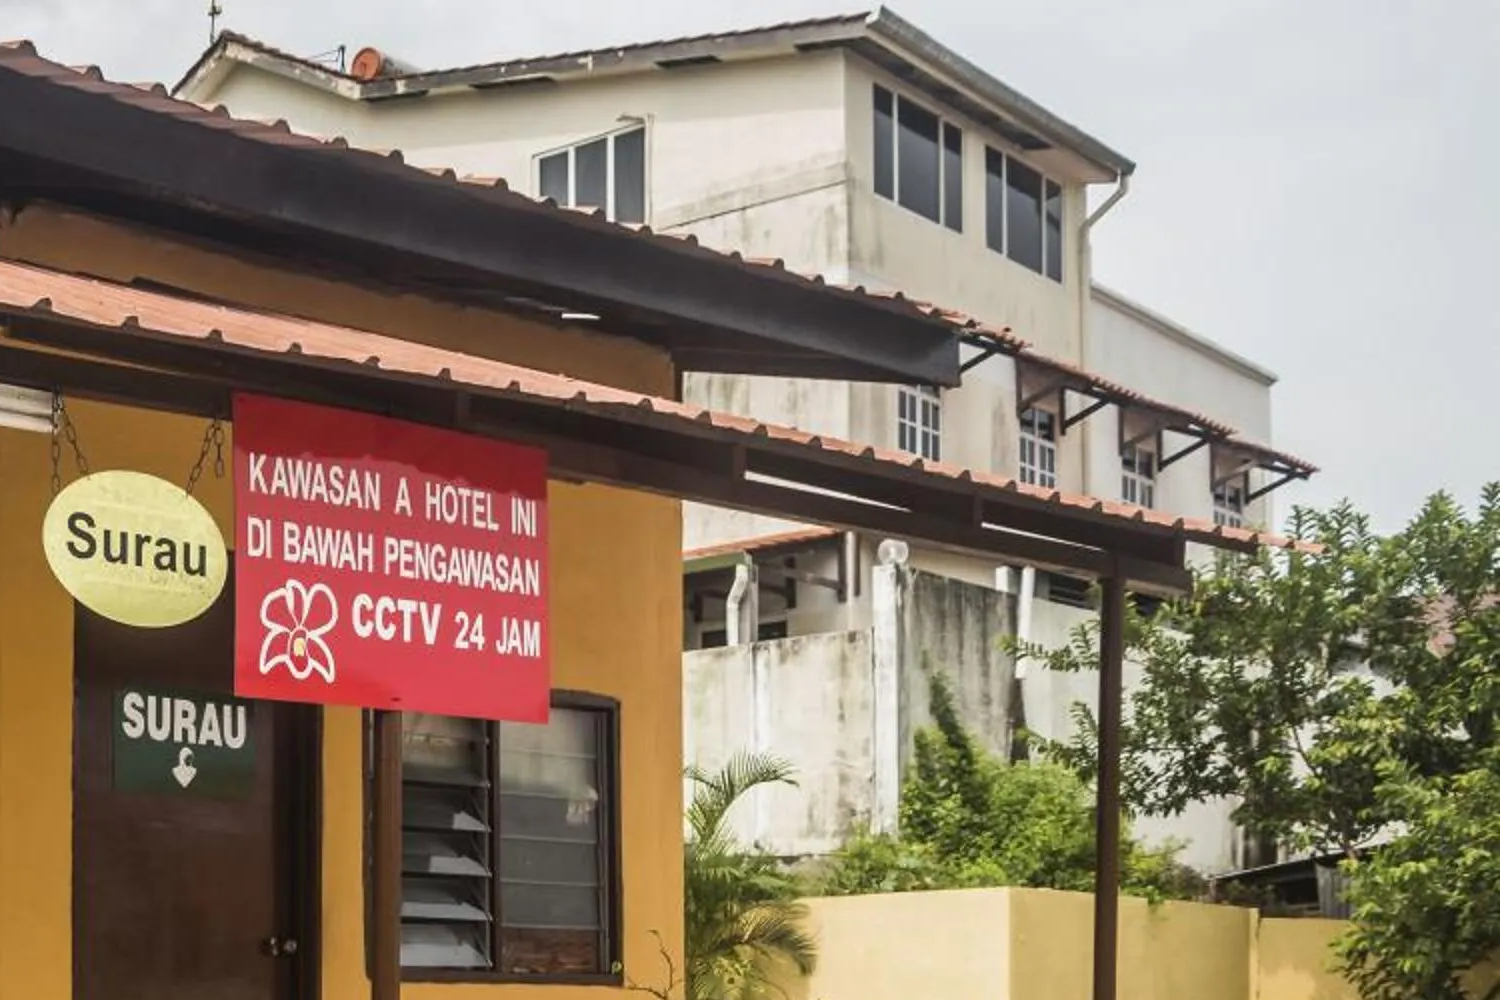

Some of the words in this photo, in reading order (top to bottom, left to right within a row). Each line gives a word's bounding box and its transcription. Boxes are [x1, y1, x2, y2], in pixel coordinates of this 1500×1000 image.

[249, 452, 381, 511] KAWASAN
[395, 476, 412, 517] A
[425, 481, 500, 532] HOTEL
[511, 496, 537, 537] INI
[66, 511, 207, 577] Surau
[247, 515, 272, 559] DI
[283, 521, 373, 573] BAWAH
[384, 536, 540, 597] PENGAWASAN
[352, 593, 442, 645] CCTV
[454, 610, 486, 651] 24
[495, 616, 541, 657] JAM
[121, 691, 247, 749] SURAU
